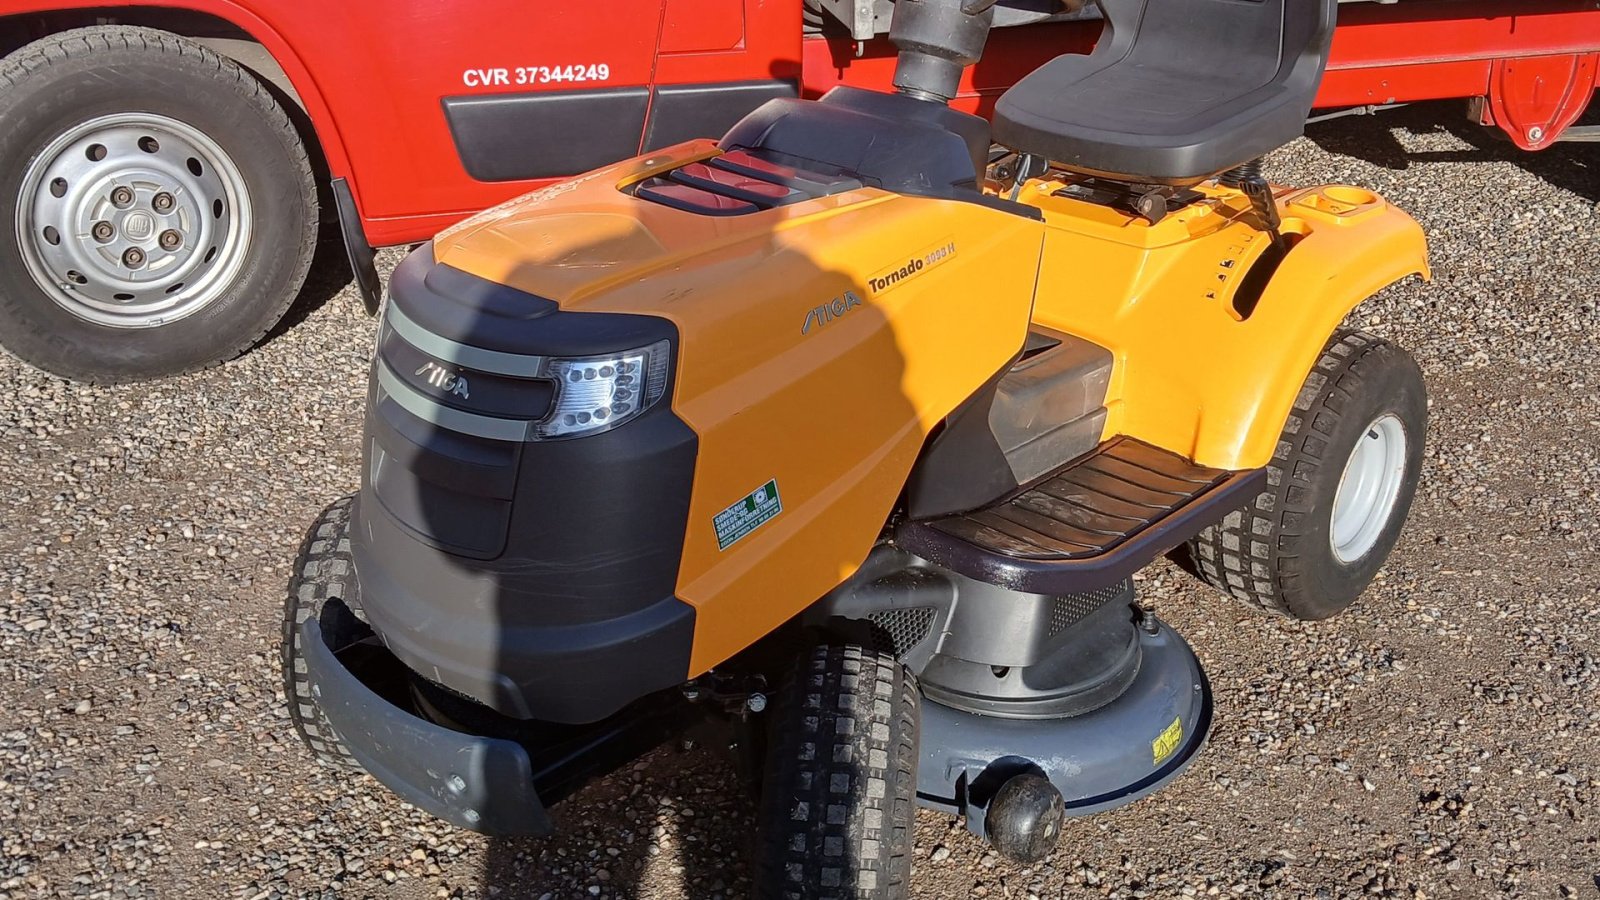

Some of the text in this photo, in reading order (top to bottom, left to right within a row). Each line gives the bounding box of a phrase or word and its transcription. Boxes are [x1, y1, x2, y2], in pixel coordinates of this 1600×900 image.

[463, 63, 610, 87] CVR 37344249
[868, 257, 924, 294] Tornado
[947, 242, 955, 255] H
[801, 290, 862, 336] STIGA
[414, 361, 470, 400] STIGA
